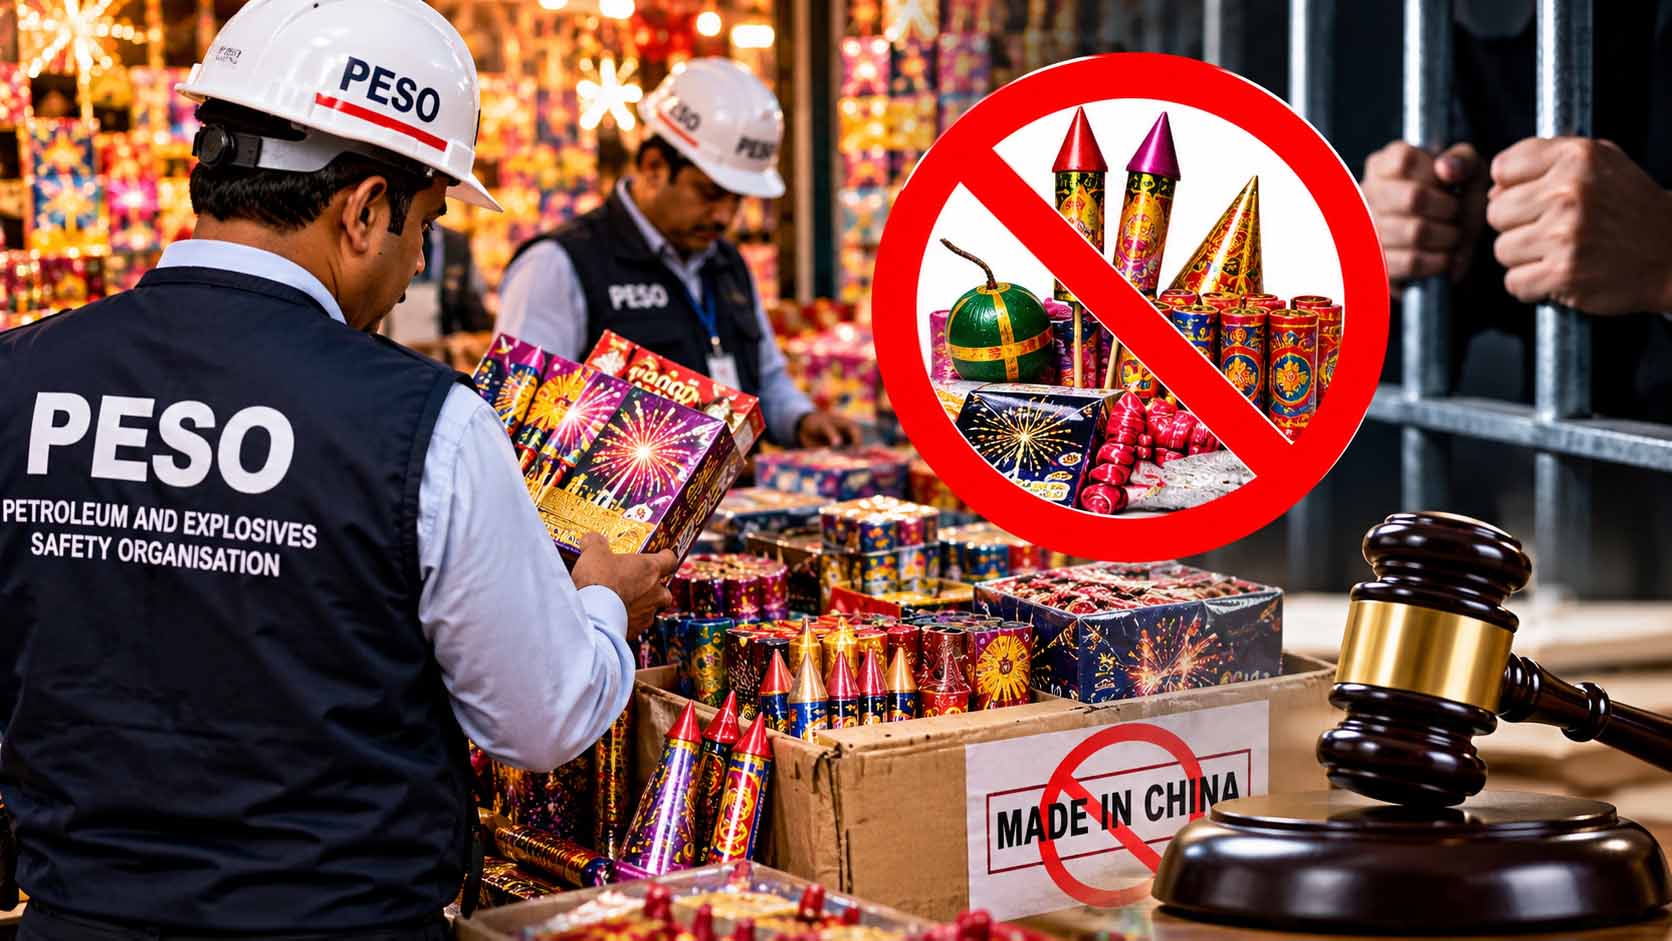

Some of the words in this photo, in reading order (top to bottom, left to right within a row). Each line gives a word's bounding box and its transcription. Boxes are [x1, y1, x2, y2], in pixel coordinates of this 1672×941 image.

[339, 56, 441, 123] PESO
[608, 283, 669, 311] PESO
[26, 391, 295, 495] PESO
[2, 499, 129, 529] PETROLEUM
[133, 506, 178, 534] AND
[183, 511, 318, 549] EXPLOSIVES
[31, 532, 112, 561] SAFETY
[117, 537, 281, 577] ORGANISATION
[996, 798, 1089, 850] MADE
[1101, 789, 1133, 832] IN
[1144, 771, 1240, 823] CHINA
